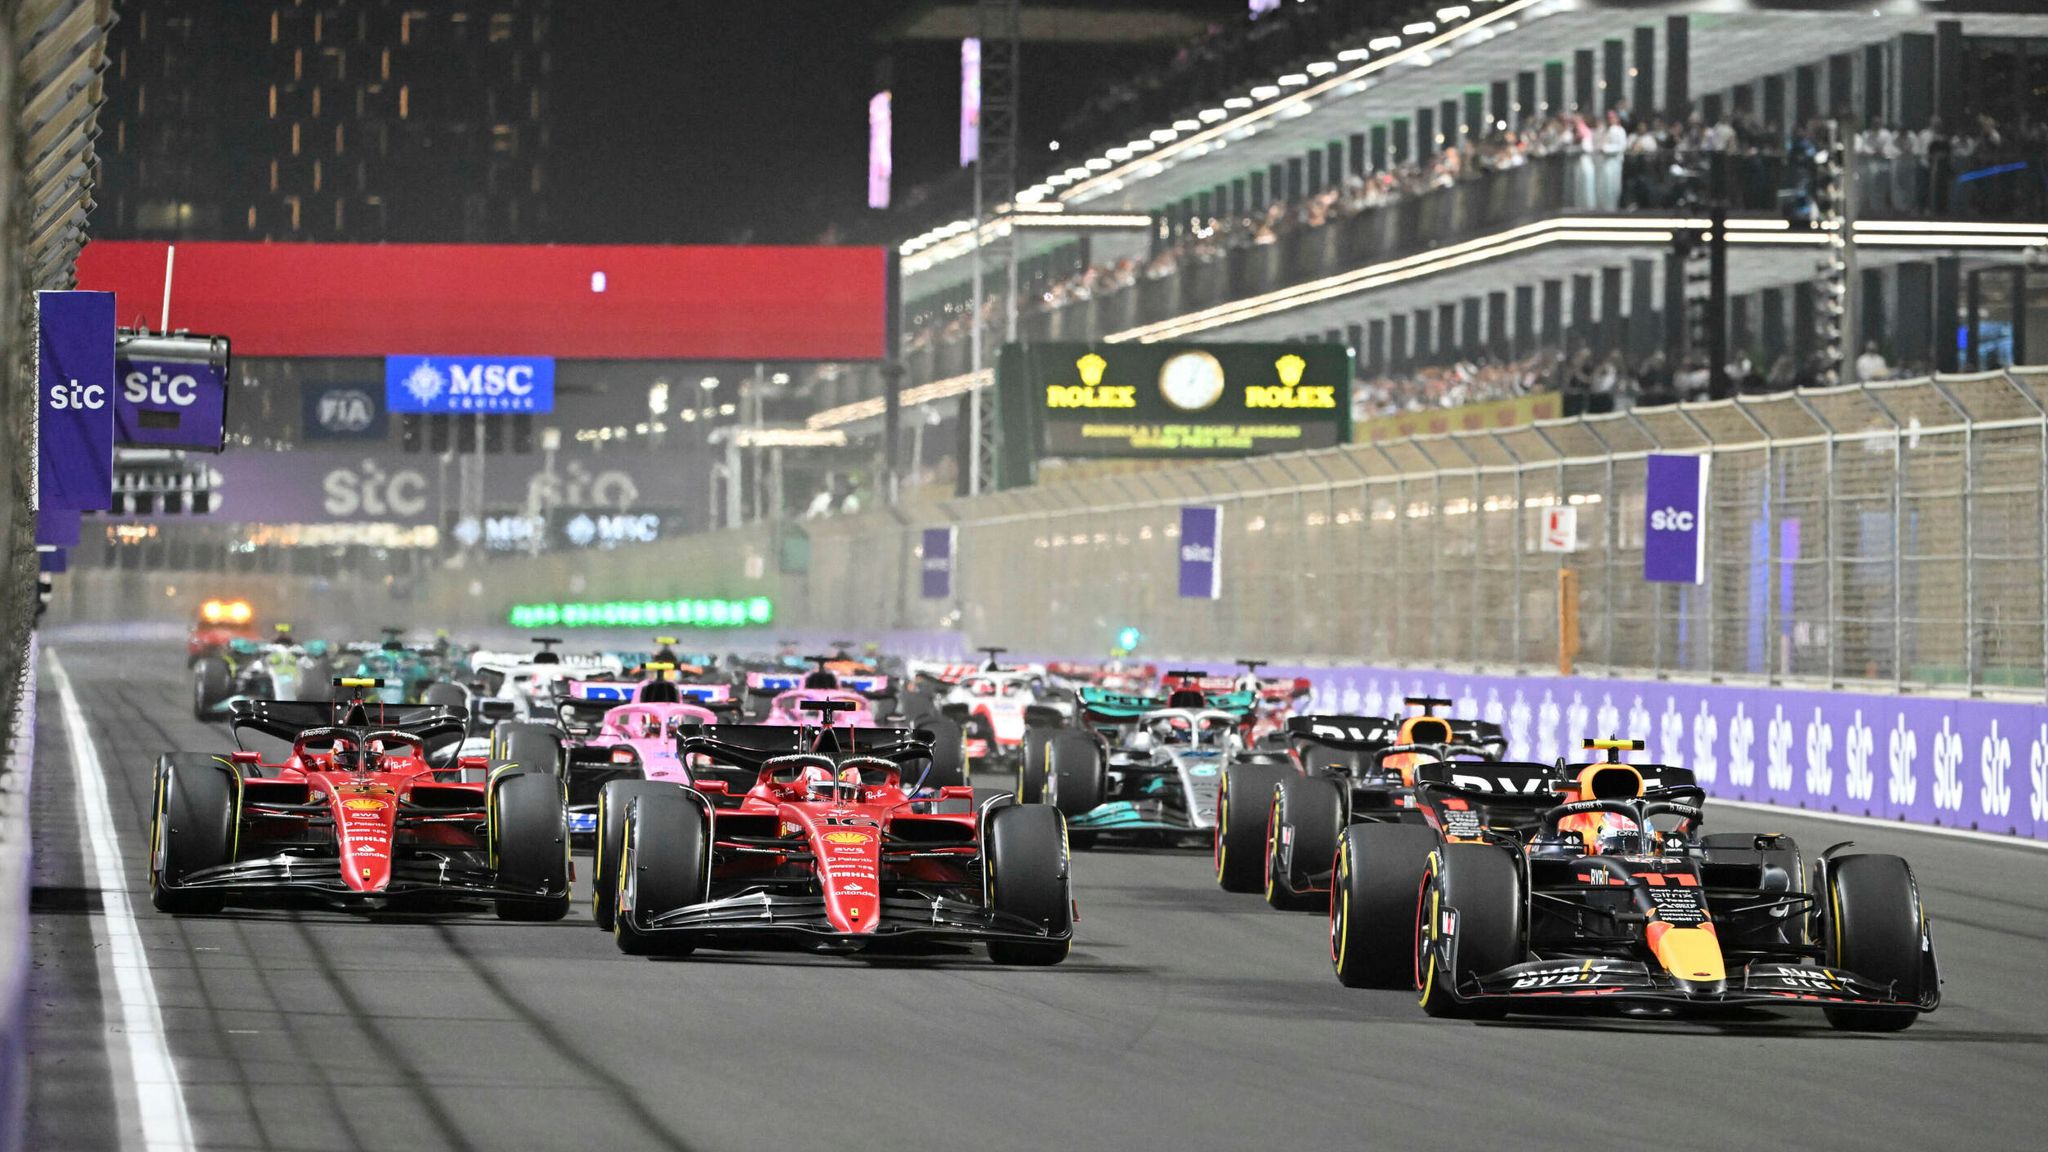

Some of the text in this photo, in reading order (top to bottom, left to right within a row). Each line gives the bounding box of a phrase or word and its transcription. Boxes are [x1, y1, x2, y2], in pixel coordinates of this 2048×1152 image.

[50, 379, 105, 410] stc
[124, 366, 197, 406] stc
[449, 364, 534, 396] MSC
[1047, 385, 1137, 408] ROLEX
[1245, 385, 1337, 408] ROLEX
[322, 457, 427, 516] stc
[1651, 506, 1694, 532] stc
